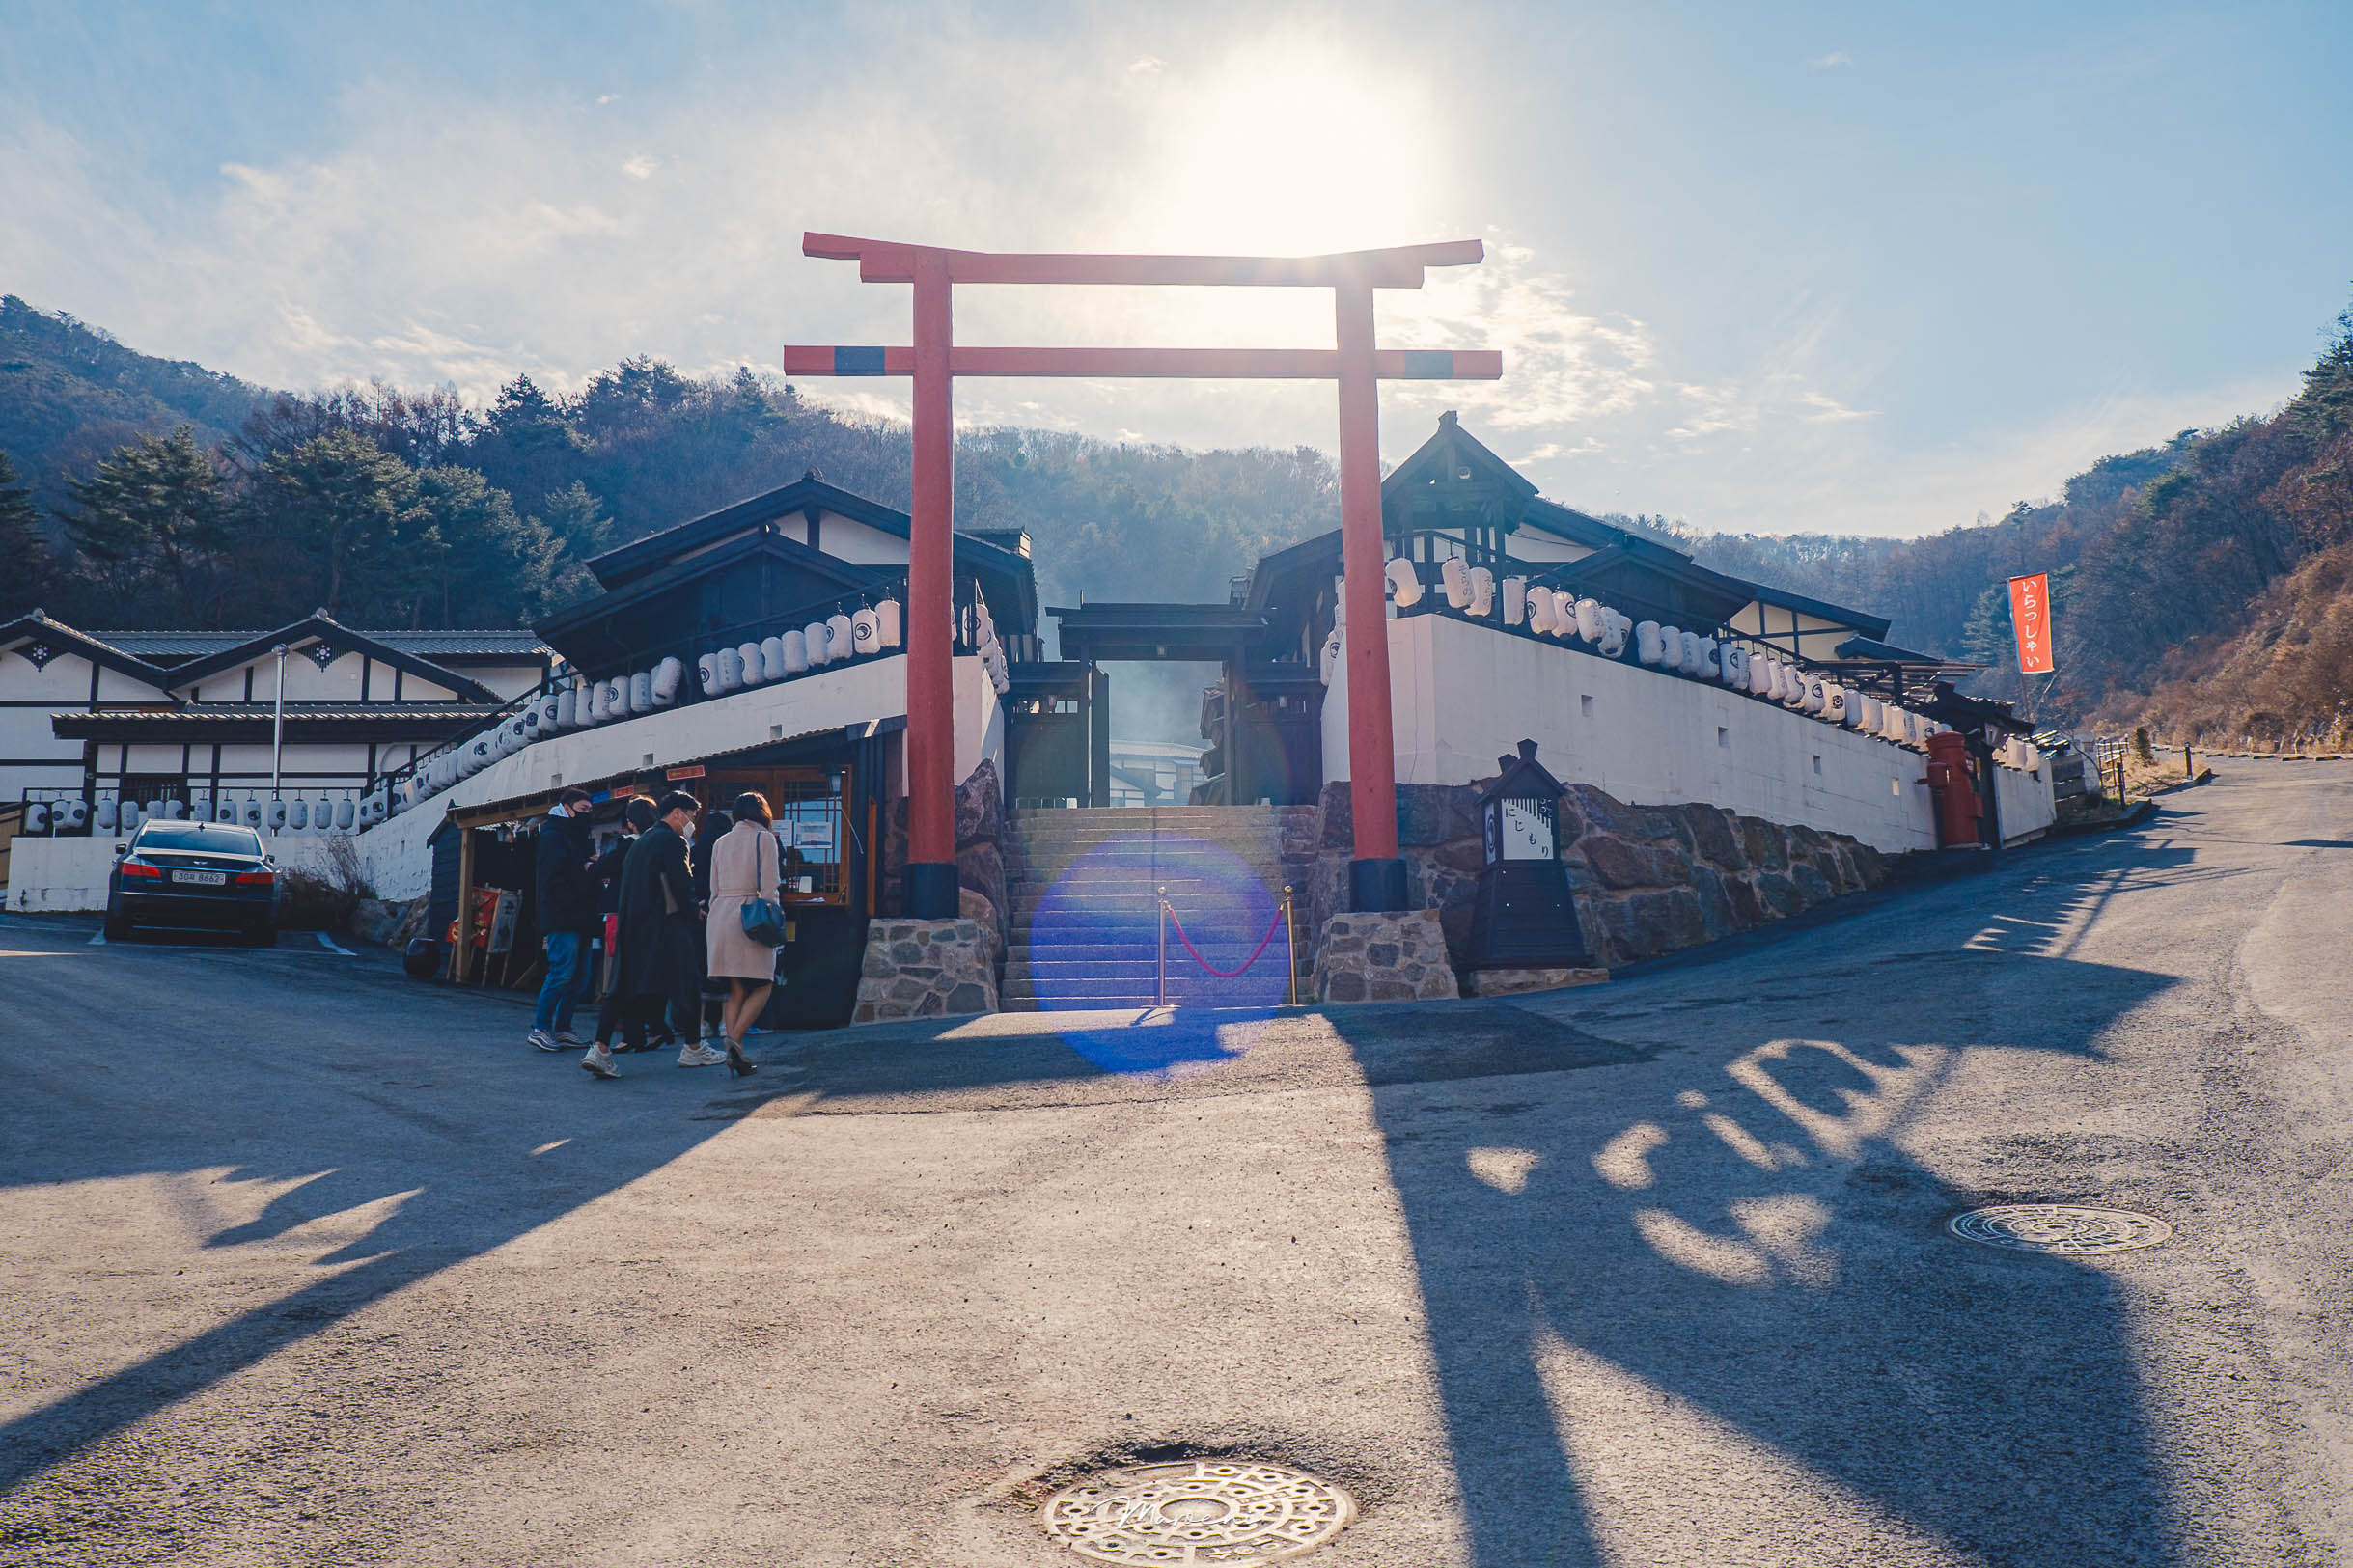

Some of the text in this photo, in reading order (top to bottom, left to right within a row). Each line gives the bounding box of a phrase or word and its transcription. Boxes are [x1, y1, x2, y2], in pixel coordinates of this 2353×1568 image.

[2021, 580, 2040, 668] いらっしゃい
[1505, 808, 1549, 858] にじもり
